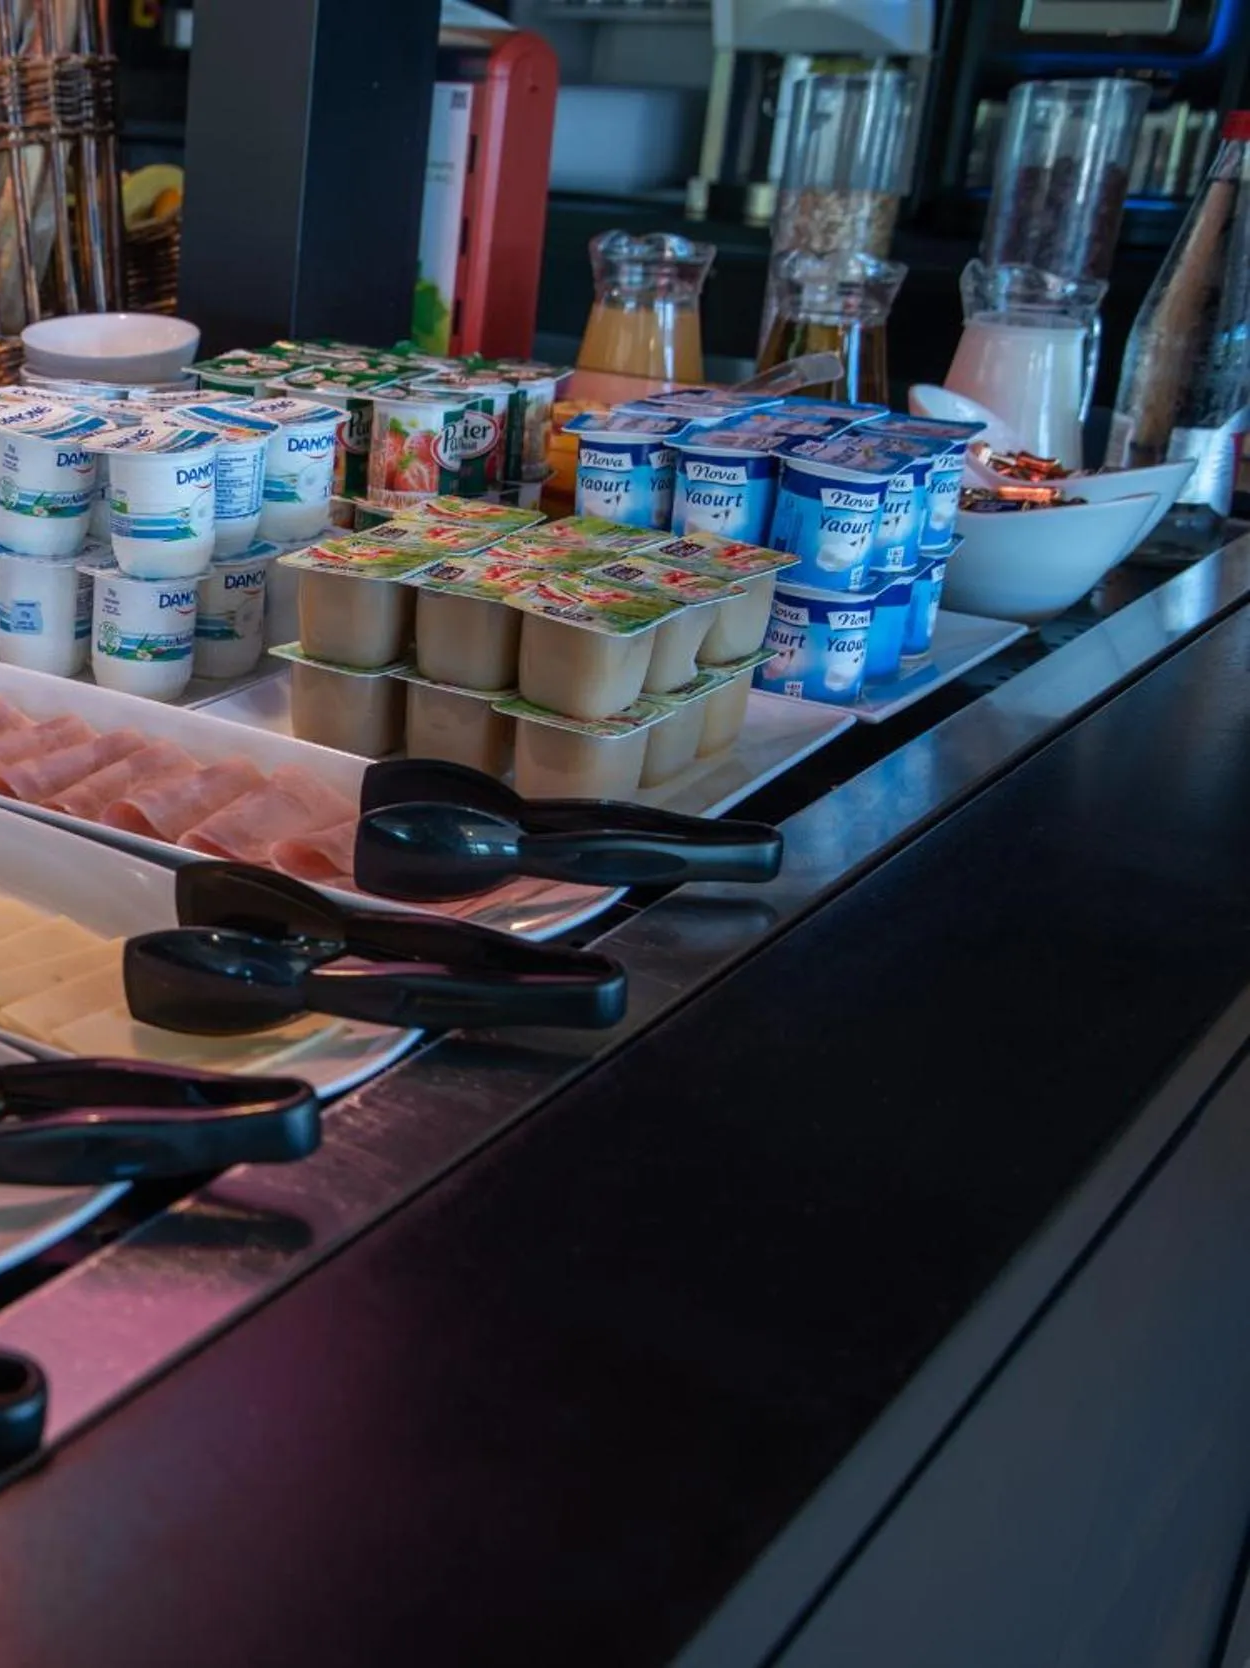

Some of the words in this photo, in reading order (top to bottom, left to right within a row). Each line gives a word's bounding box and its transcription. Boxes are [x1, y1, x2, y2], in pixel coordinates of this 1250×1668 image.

[583, 450, 625, 468] Nova
[693, 464, 739, 482] Nova
[685, 487, 744, 508] Yaourt
[830, 490, 875, 508] Nova
[819, 515, 875, 535] Yaourt
